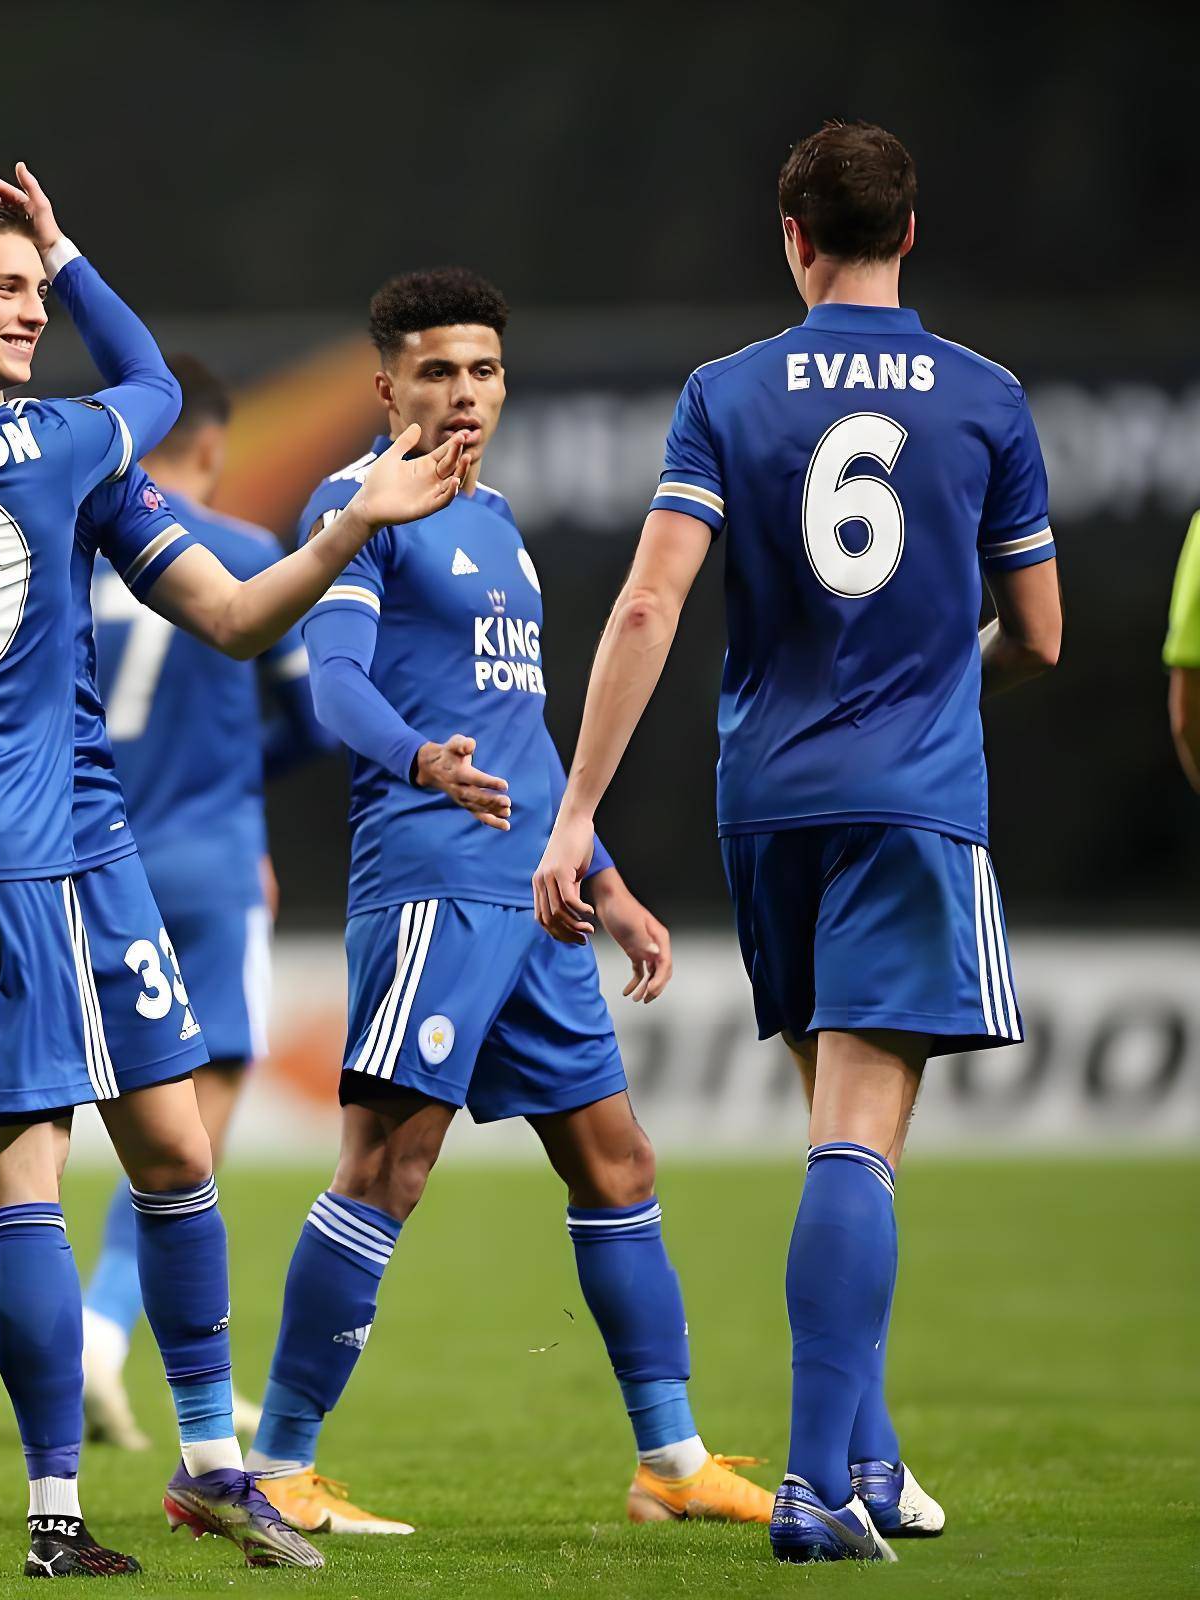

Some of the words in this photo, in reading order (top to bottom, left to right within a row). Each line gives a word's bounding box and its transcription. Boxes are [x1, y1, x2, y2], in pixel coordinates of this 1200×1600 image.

[786, 352, 936, 392] EVANS
[801, 411, 909, 599] 6
[473, 616, 541, 662] KING
